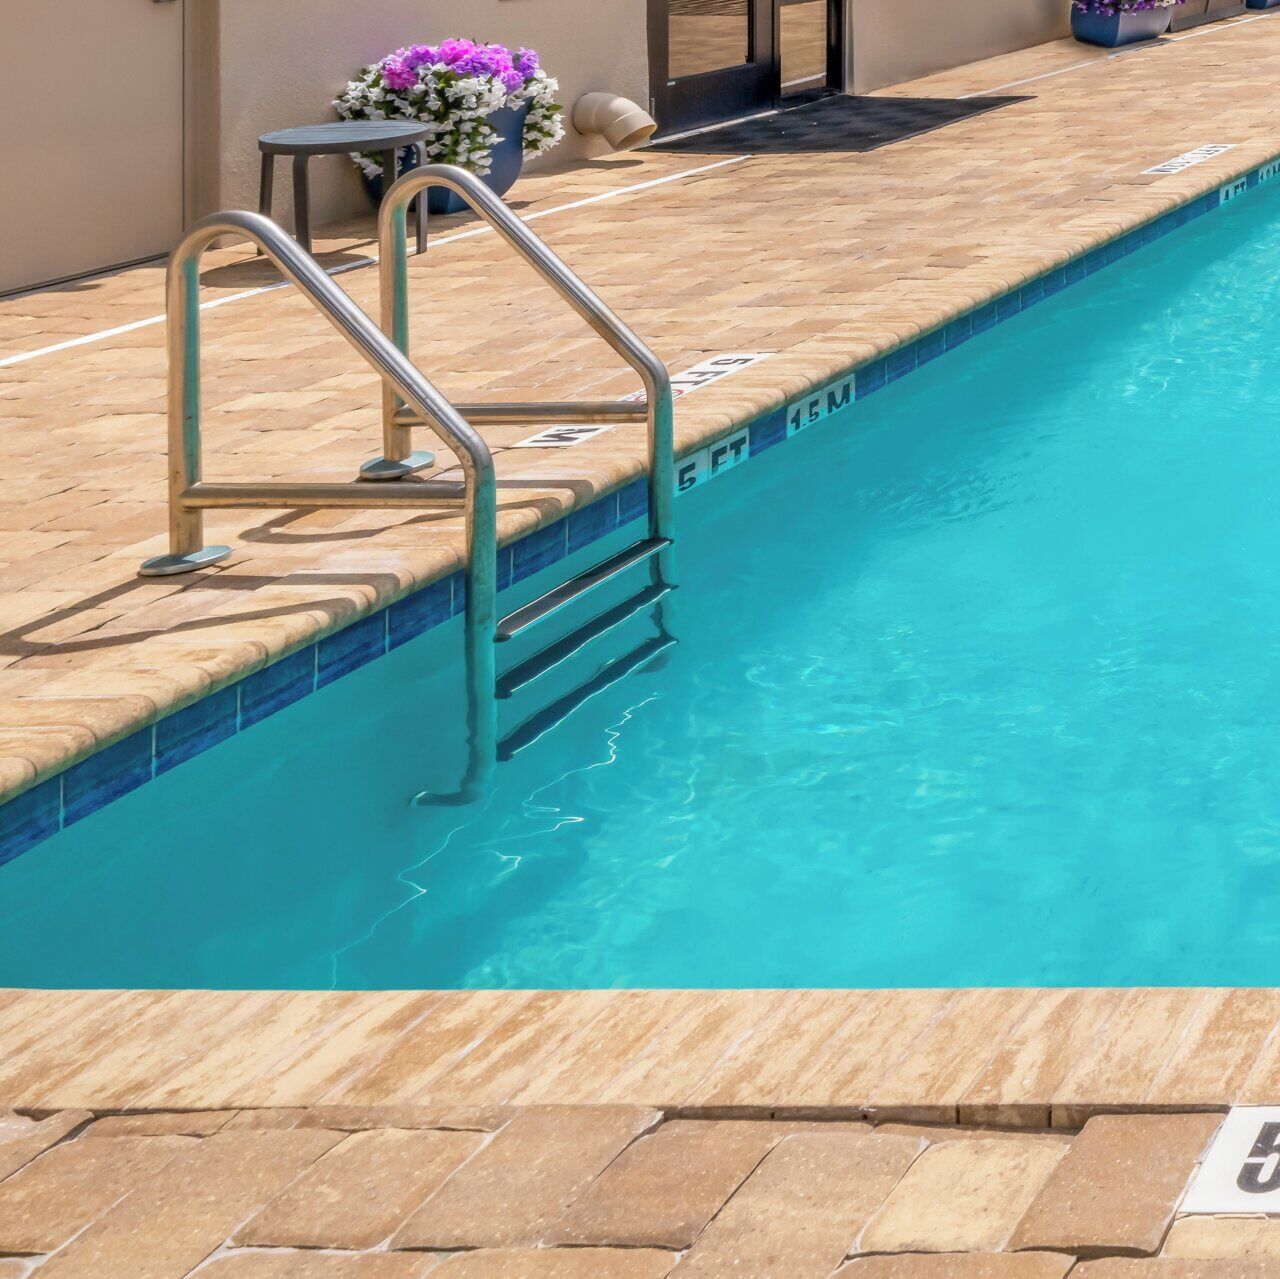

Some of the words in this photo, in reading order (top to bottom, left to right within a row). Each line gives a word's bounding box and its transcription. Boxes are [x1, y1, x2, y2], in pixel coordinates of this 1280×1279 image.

[827, 382, 851, 415] M
[677, 462, 697, 492] 5
[711, 435, 747, 476] FT
